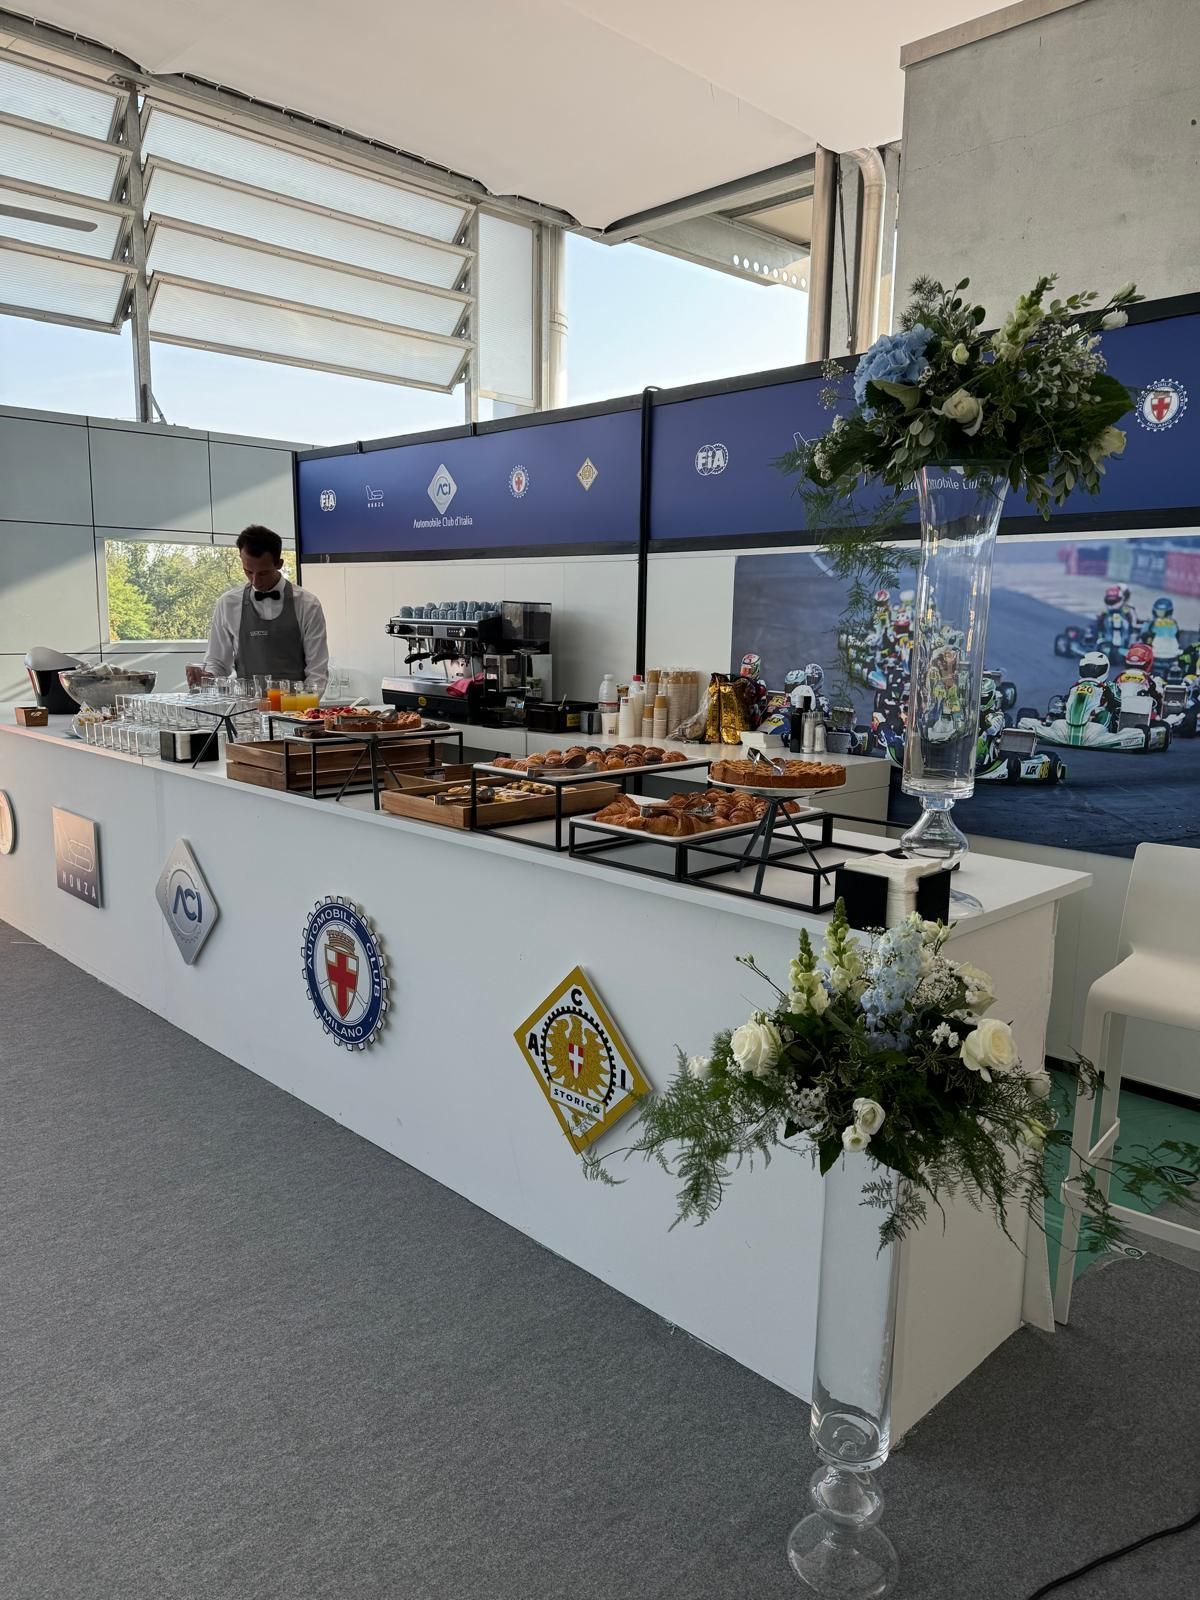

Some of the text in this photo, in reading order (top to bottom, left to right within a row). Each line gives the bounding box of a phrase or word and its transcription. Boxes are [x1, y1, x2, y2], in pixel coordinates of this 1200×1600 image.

[436, 483, 451, 497] ACI
[413, 518, 441, 528] Automobile
[442, 517, 454, 527] Club
[62, 872, 96, 899] MONZA
[172, 884, 203, 924] ACI
[306, 908, 380, 998] AUTOMOBILE CLUB
[322, 1008, 364, 1038] MILANO
[553, 1088, 600, 1115] STORICO
